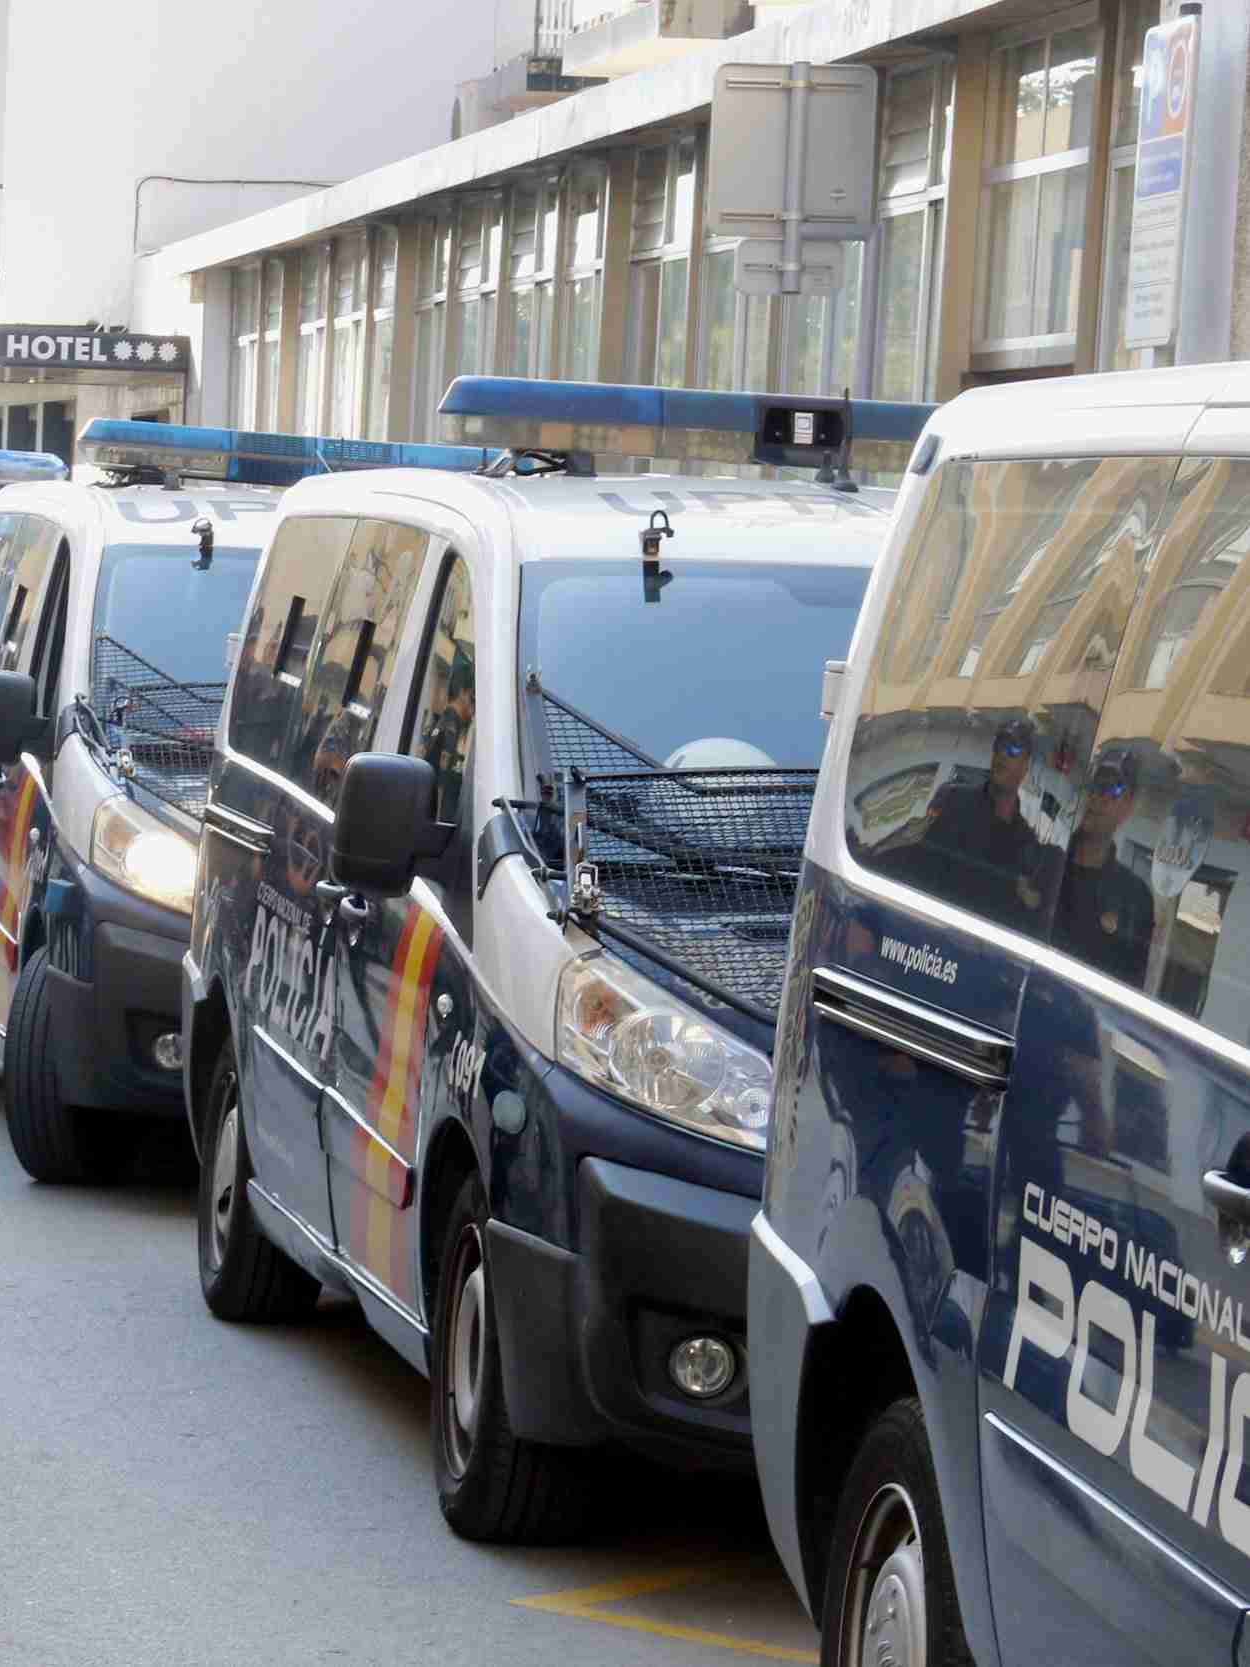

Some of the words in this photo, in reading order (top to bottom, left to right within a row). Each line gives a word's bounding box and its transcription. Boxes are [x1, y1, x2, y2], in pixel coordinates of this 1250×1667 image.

[6, 335, 108, 363] HOTEL
[1022, 1181, 1118, 1271] CUERPO
[1124, 1238, 1250, 1350] NACIONAL
